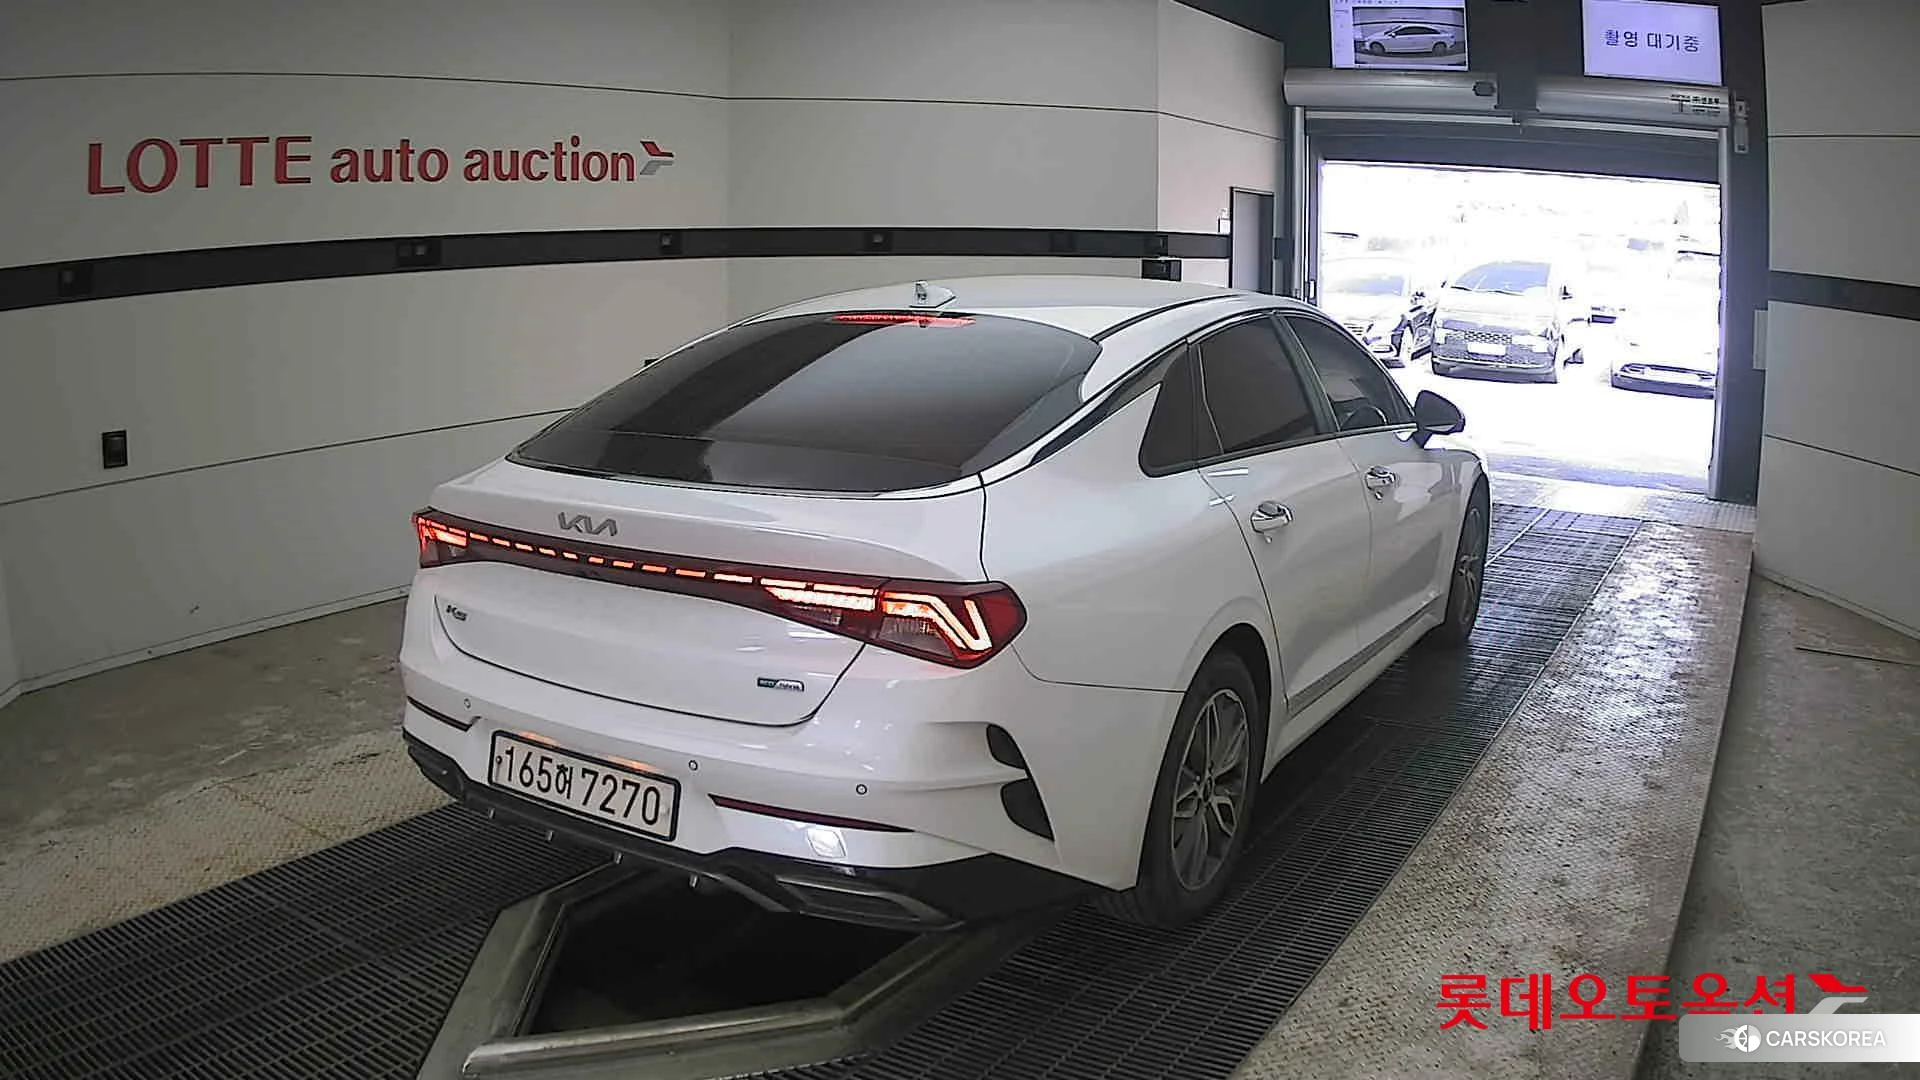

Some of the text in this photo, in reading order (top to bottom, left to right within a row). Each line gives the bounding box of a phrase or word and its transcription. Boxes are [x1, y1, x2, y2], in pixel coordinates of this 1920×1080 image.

[1646, 32, 1699, 53] 대기중
[86, 135, 636, 195] LOTTE auto auction
[581, 767, 661, 826] 7270
